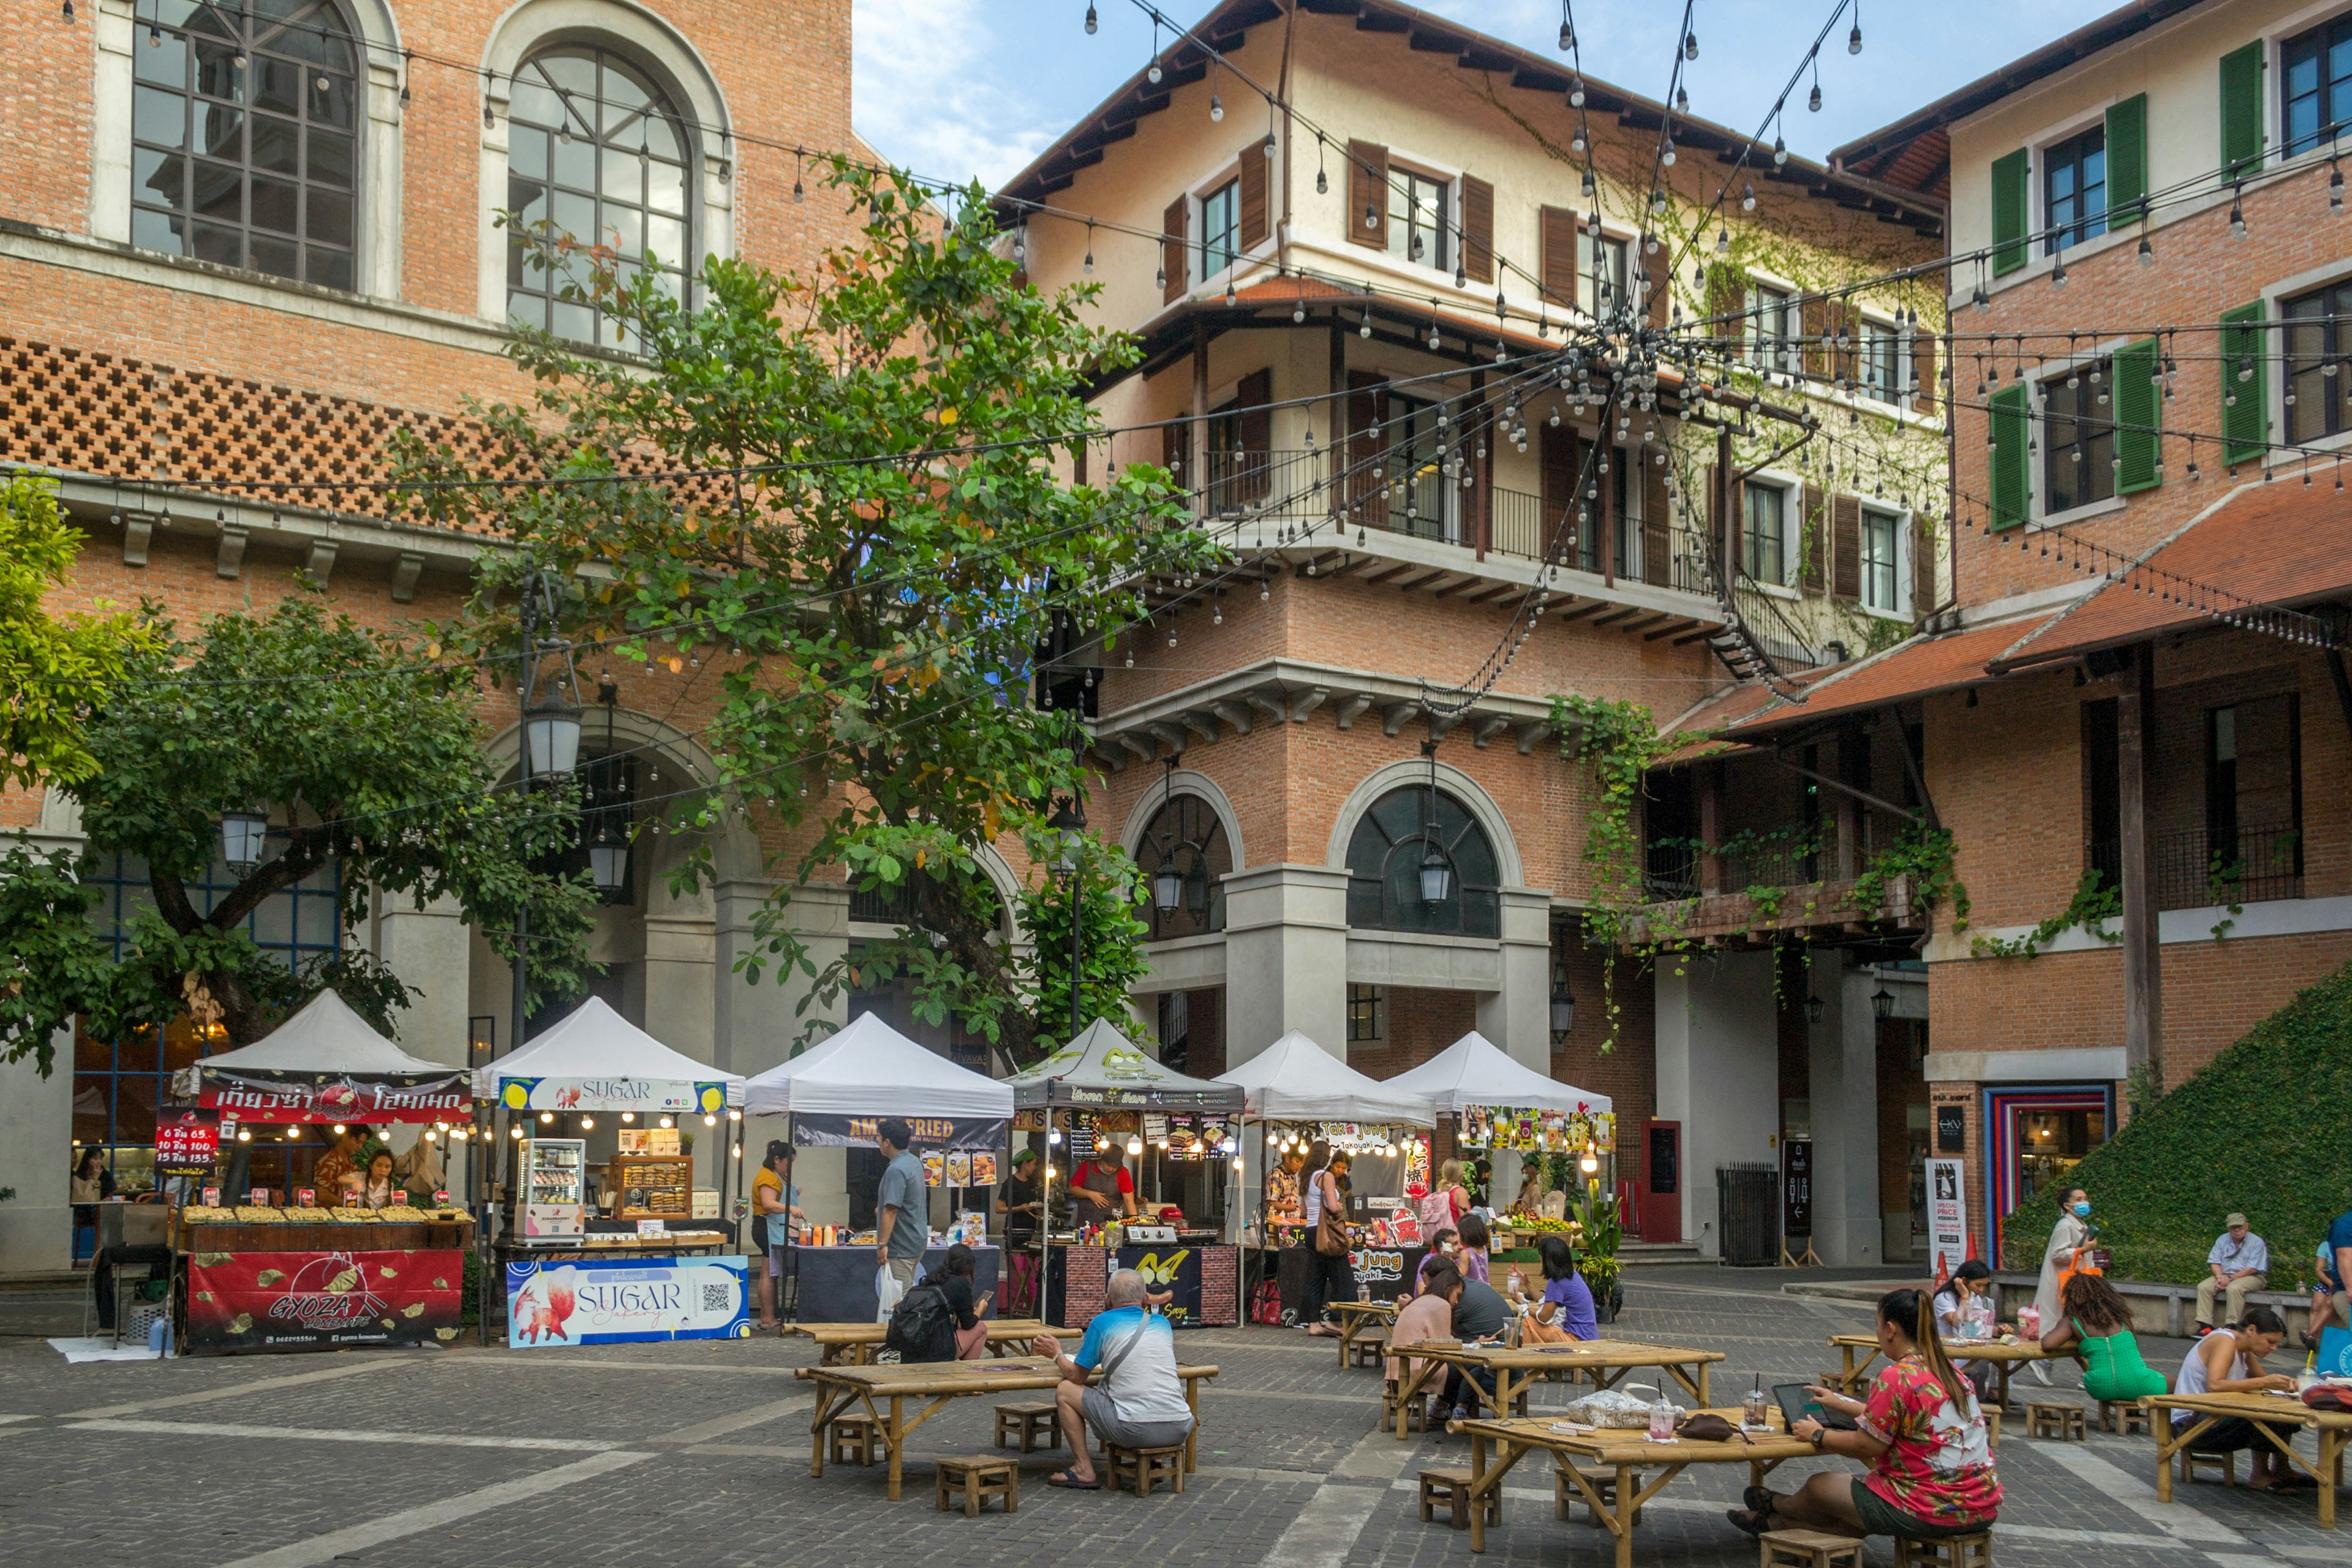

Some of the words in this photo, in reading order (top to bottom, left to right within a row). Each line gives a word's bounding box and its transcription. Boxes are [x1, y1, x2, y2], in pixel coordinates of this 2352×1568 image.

[583, 1080, 650, 1099] SUGAR
[164, 1129, 172, 1137] 6
[906, 1119, 953, 1137] FRIED
[1357, 1122, 1388, 1140] jung
[159, 1140, 171, 1149] 10
[1341, 1141, 1373, 1151] Takoyaki
[157, 1152, 170, 1161] 15
[1360, 1251, 1401, 1270] jung
[270, 1295, 352, 1319] GYOZA
[579, 1284, 681, 1313] SUGAR
[592, 1300, 668, 1329] Bakery
[1164, 1303, 1187, 1319] Sage
[304, 1316, 371, 1329] HOMEMADE
